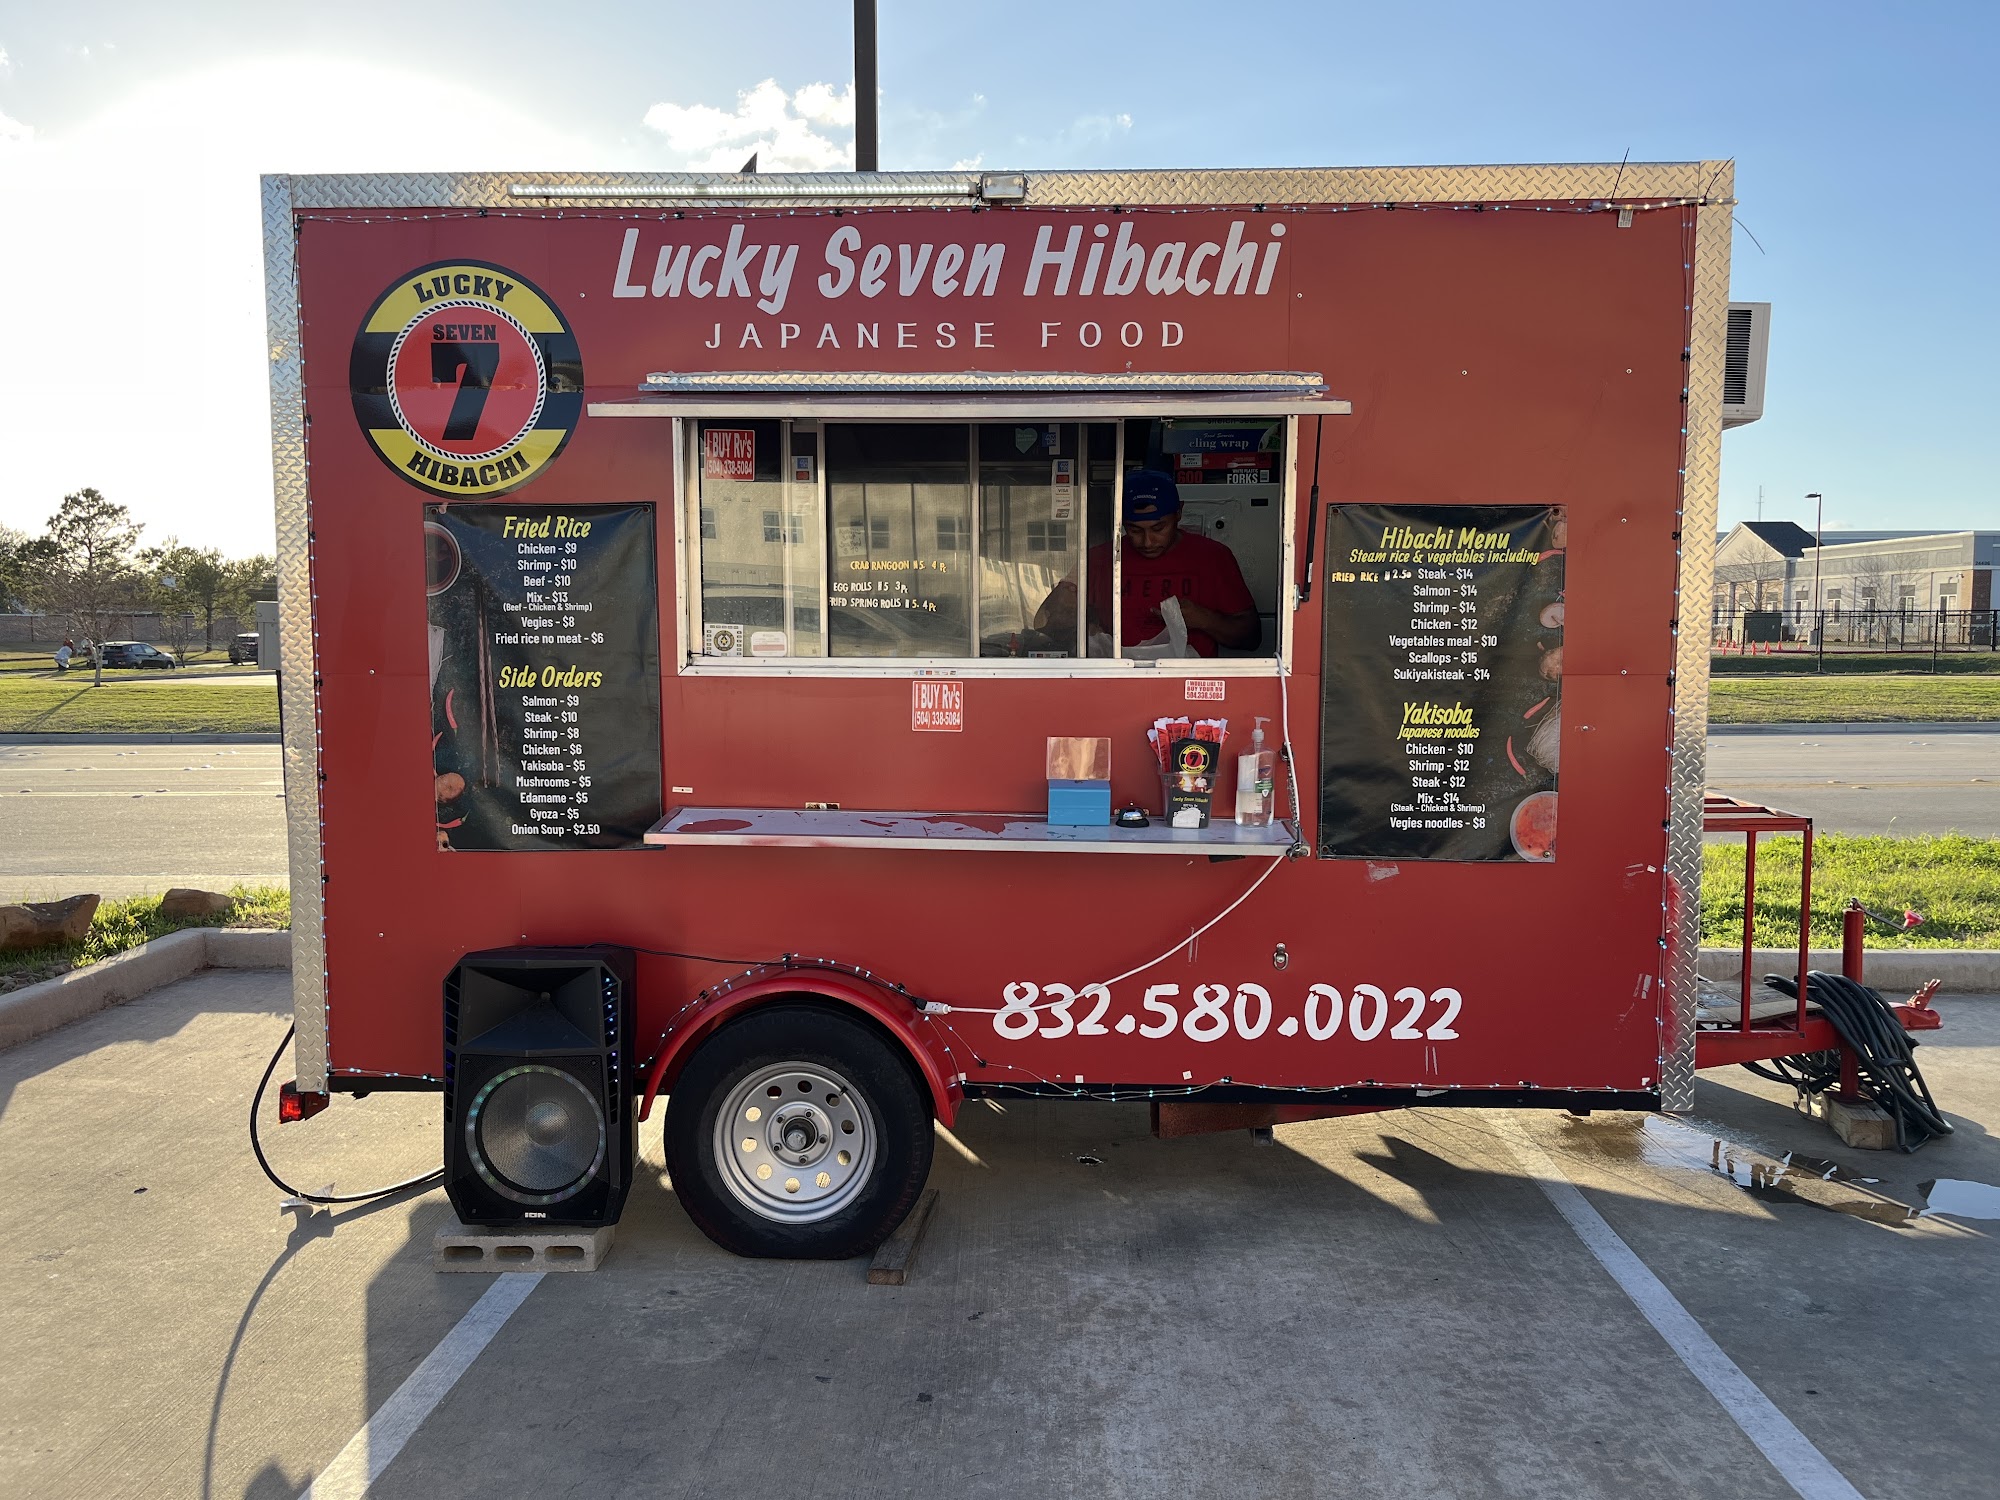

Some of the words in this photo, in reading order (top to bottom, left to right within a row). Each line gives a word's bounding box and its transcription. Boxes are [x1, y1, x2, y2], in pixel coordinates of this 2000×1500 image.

[612, 223, 800, 316] Lucky
[817, 225, 1006, 299] Seven
[1022, 220, 1287, 297] Hibachi
[413, 274, 514, 303] LUCKY
[433, 324, 496, 341] SEVEN
[705, 321, 995, 349] JAPANESE
[1041, 321, 1184, 348] FOOD
[431, 343, 499, 440] 7
[707, 432, 710, 458] I
[713, 432, 731, 458] BUY
[734, 432, 752, 458] Rv's
[1189, 438, 1217, 450] cling
[1220, 440, 1249, 450] wrap
[406, 451, 531, 487] HIBACHI
[706, 460, 722, 477] (504)
[724, 460, 752, 475] 338-5084
[1177, 470, 1203, 484] 600
[1227, 474, 1258, 484] FORKS
[503, 515, 551, 538] Fried
[554, 515, 592, 538] Rice
[1380, 526, 1454, 550] Hibachi
[1457, 527, 1510, 550] Menu
[518, 543, 556, 554] Chicken
[565, 542, 577, 555] $9
[1350, 549, 1386, 563] Steam
[1389, 549, 1409, 563] rice
[1413, 550, 1423, 563] &
[1427, 549, 1485, 565] vegetables
[1488, 549, 1540, 565] including
[518, 559, 551, 573] Shrimp
[561, 558, 577, 571] $10
[850, 561, 869, 570] CRAB
[871, 560, 910, 571] RANGOON
[932, 561, 937, 570] 4
[1332, 572, 1355, 582] FRIED
[1361, 572, 1378, 582] RICE
[1418, 568, 1446, 579] Steak
[1456, 568, 1473, 580] $14
[524, 576, 545, 586] Beef
[555, 575, 571, 588] $10
[833, 582, 848, 592] EGG
[850, 582, 872, 592] ROLLS
[527, 592, 543, 603] Mix
[552, 591, 568, 603] $13
[1413, 585, 1450, 596] Salmon
[1460, 584, 1477, 597] $14
[503, 603, 522, 612] (Beef
[529, 603, 556, 611] Chicken
[558, 603, 563, 611] &
[565, 603, 592, 612] Shrimp)
[850, 598, 878, 608] SPRING
[880, 598, 901, 609] ROLLS
[1413, 601, 1449, 615] Shrimp
[1459, 601, 1476, 614] $14
[521, 617, 553, 630] Vegies
[563, 615, 575, 628] $8
[1411, 619, 1451, 630] Chicken
[1461, 618, 1477, 631] $12
[496, 633, 518, 644] Fried
[521, 633, 539, 644] rice
[542, 636, 554, 644] no
[557, 633, 581, 644] meat
[591, 632, 604, 645] $6
[1389, 635, 1444, 649] Vegetables
[1447, 635, 1472, 646] meal
[1481, 634, 1498, 647] $10
[1408, 652, 1451, 665] Scallops
[1461, 651, 1477, 664] $15
[499, 665, 537, 688] Side
[541, 665, 602, 688] Orders
[1393, 668, 1464, 682] Sukiyakisteak
[1474, 668, 1490, 681] $14
[522, 695, 557, 706] Salmon
[567, 695, 579, 707] $9
[915, 684, 918, 708] I
[921, 684, 940, 709] BUY
[942, 684, 960, 709] Rv's
[525, 712, 552, 722] Steak
[561, 711, 578, 723] $10
[915, 711, 930, 728] (504)
[932, 711, 960, 725] 338-5084
[1402, 701, 1473, 725] Yakisoba
[524, 727, 558, 741] Shrimp
[567, 727, 579, 739] $8
[1397, 724, 1442, 741] Japanese
[1444, 724, 1480, 739] noodles
[522, 744, 560, 755] Chicken
[570, 743, 582, 756] $6
[1406, 743, 1445, 755] Chicken
[1457, 742, 1474, 756] $10
[521, 760, 564, 771] Yakisoba
[573, 759, 585, 772] $5
[1409, 759, 1444, 773] Shrimp
[1453, 759, 1470, 772] $12
[516, 776, 570, 787] Mushrooms
[579, 775, 591, 788] $5
[1412, 776, 1440, 787] Steak
[1449, 776, 1465, 788] $12
[520, 792, 567, 803] Edamame
[576, 791, 588, 804] $5
[1417, 792, 1434, 804] Mix
[1443, 792, 1459, 805] $14
[530, 808, 558, 821] Gyoza
[567, 807, 579, 820] $5
[1391, 803, 1414, 813] (Steak
[1421, 804, 1448, 812] Chicken
[1450, 804, 1455, 812] &
[1457, 804, 1486, 813] Shrimp)
[511, 824, 539, 835] Onion
[541, 824, 564, 837] Soup
[573, 823, 600, 836] $2.50
[1390, 817, 1422, 831] Vegies
[1425, 817, 1463, 828] noodles
[1472, 817, 1485, 830] $8
[992, 981, 1463, 1043] 832.580.0022
